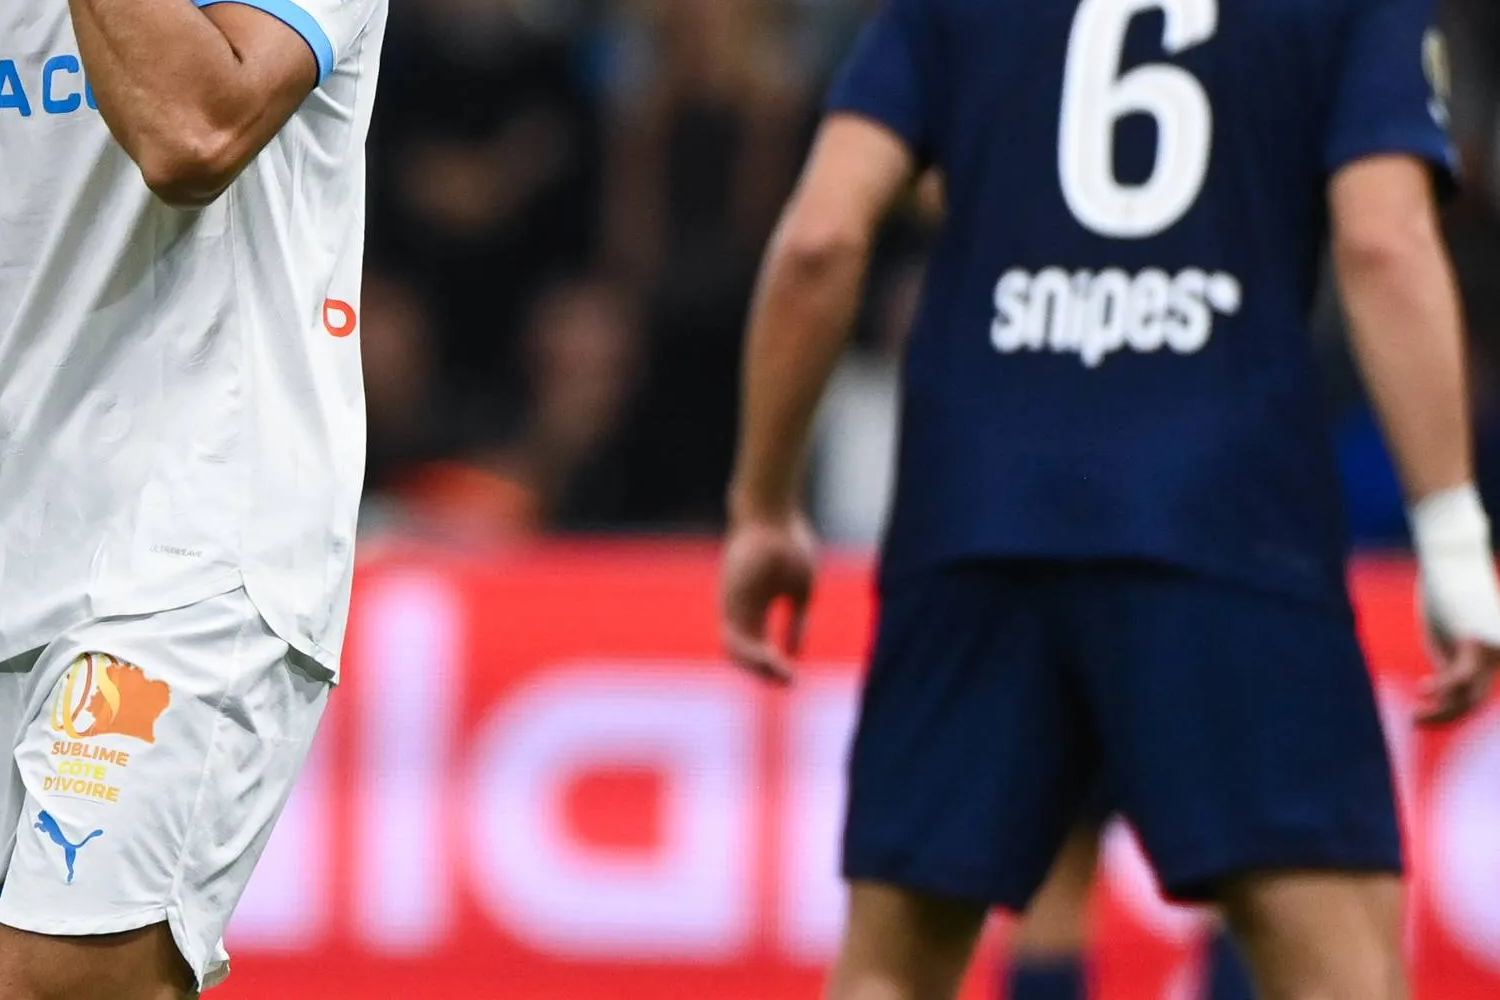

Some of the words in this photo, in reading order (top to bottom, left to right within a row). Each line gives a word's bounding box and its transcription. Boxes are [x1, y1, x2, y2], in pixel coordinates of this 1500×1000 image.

[42, 55, 101, 114] C
[990, 266, 1213, 367] snipes
[51, 741, 130, 767] SUBLIME
[43, 776, 120, 802] D'IVOIRE
